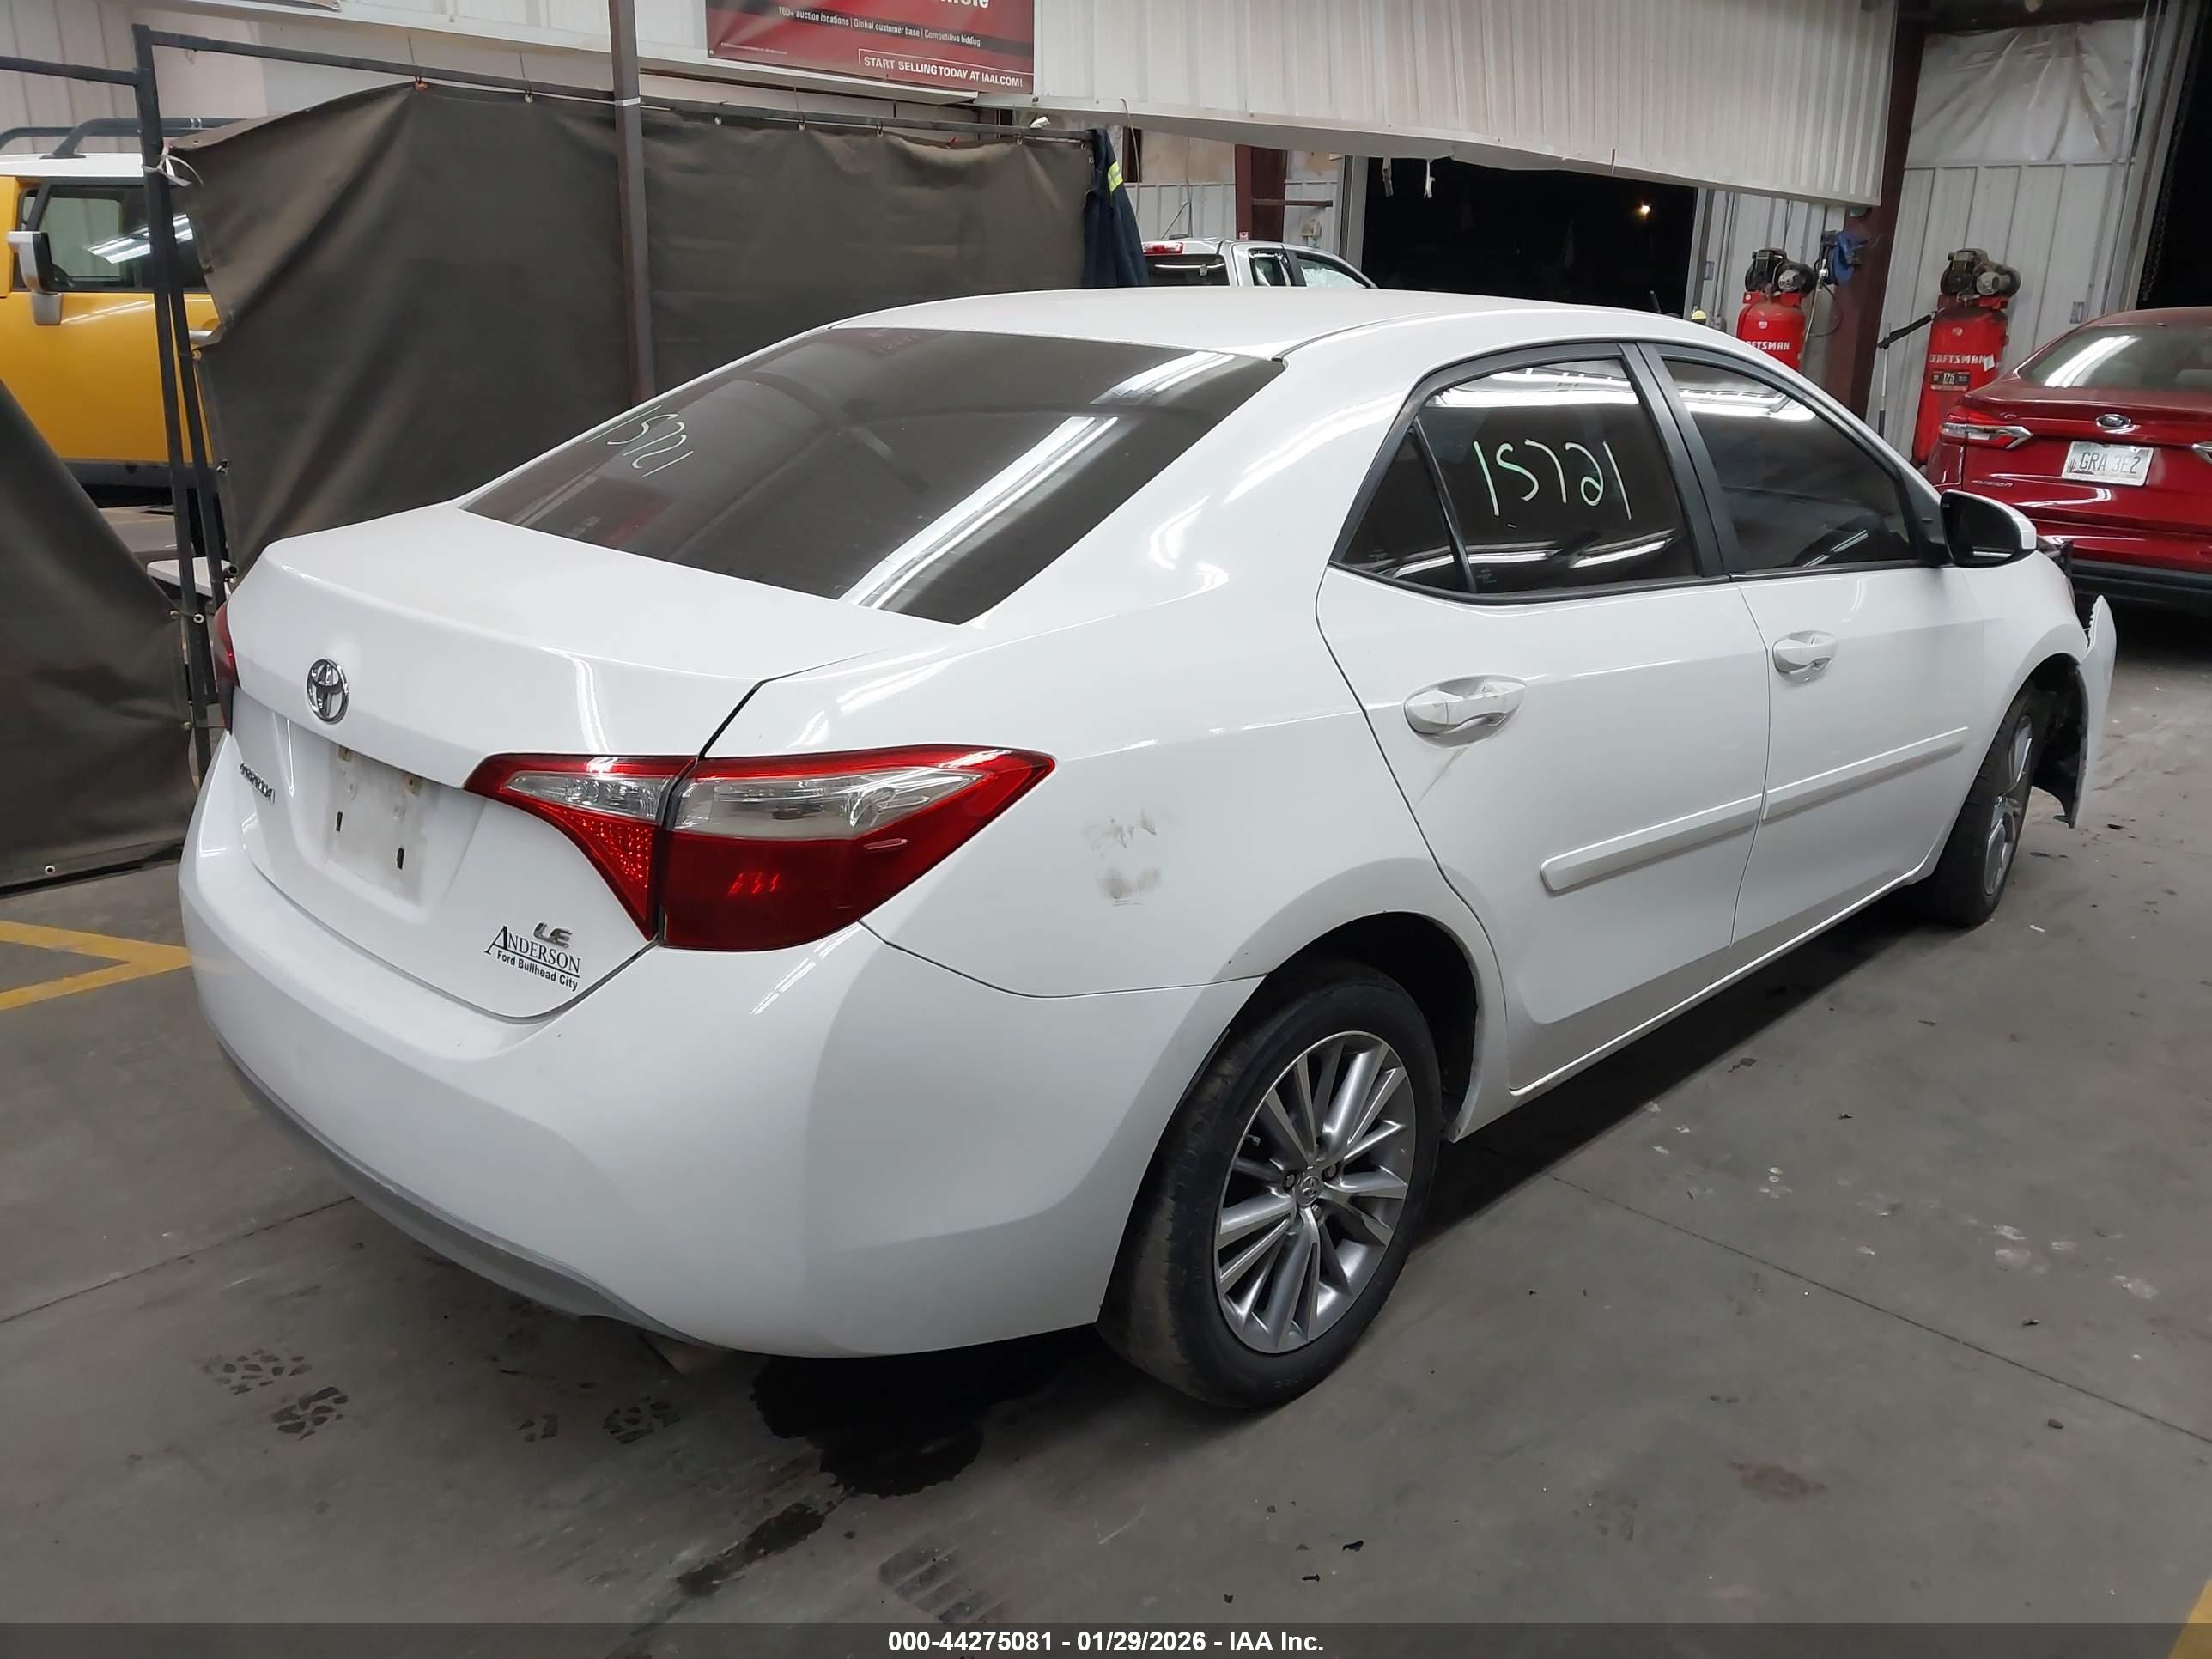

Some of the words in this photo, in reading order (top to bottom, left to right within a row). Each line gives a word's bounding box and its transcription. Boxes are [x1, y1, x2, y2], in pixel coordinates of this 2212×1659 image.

[796, 10, 820, 21] auction
[820, 13, 849, 27] locations
[854, 18, 874, 30] Global
[875, 22, 905, 34] customer
[905, 26, 920, 37] base
[924, 29, 960, 43] Competitive
[961, 34, 981, 48] bidding
[864, 56, 896, 70] START
[898, 61, 938, 76] SELLING
[939, 66, 969, 80] TODAY
[969, 70, 981, 82] AT
[981, 72, 1024, 88] IAAI.COM!
[586, 404, 695, 477] 15721
[1473, 439, 1632, 520] 15721
[2079, 452, 2108, 471] GRA
[2112, 455, 2142, 475] 3E2
[483, 925, 582, 974] ANDERSON
[533, 921, 574, 949] LE
[496, 950, 516, 966] Ford
[518, 958, 556, 981] Bullhead
[559, 975, 578, 992] City
